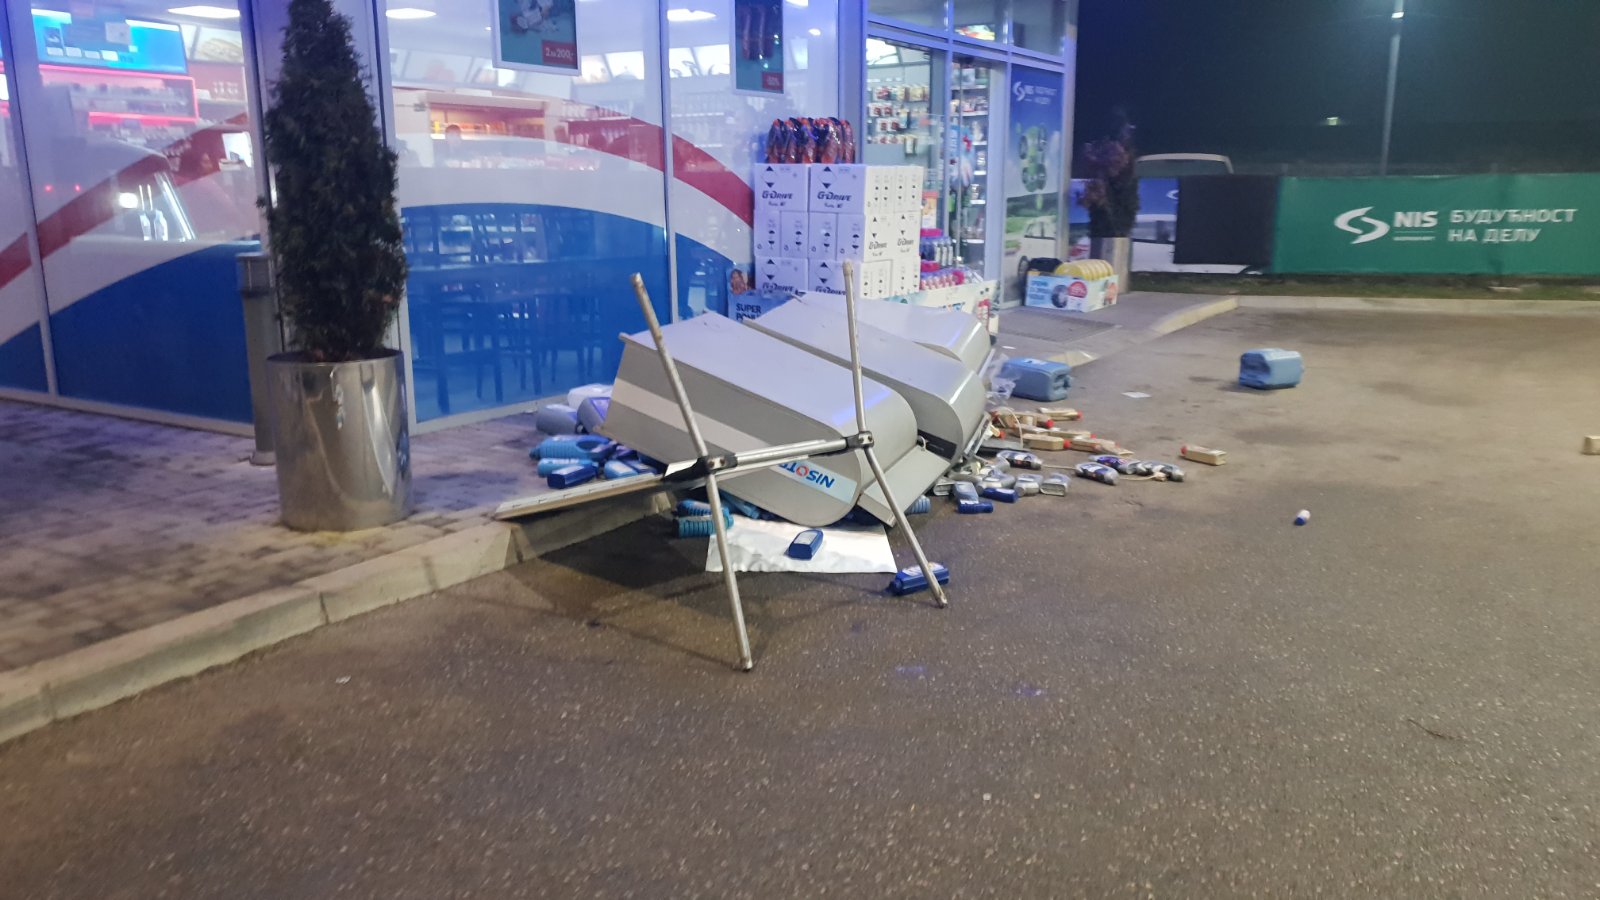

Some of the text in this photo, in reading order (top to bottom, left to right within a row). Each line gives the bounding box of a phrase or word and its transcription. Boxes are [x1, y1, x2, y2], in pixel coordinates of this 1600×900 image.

[1393, 210, 1439, 228] NIS
[1447, 228, 1542, 244] НА ДЕЛУ
[735, 302, 762, 314] SUPER
